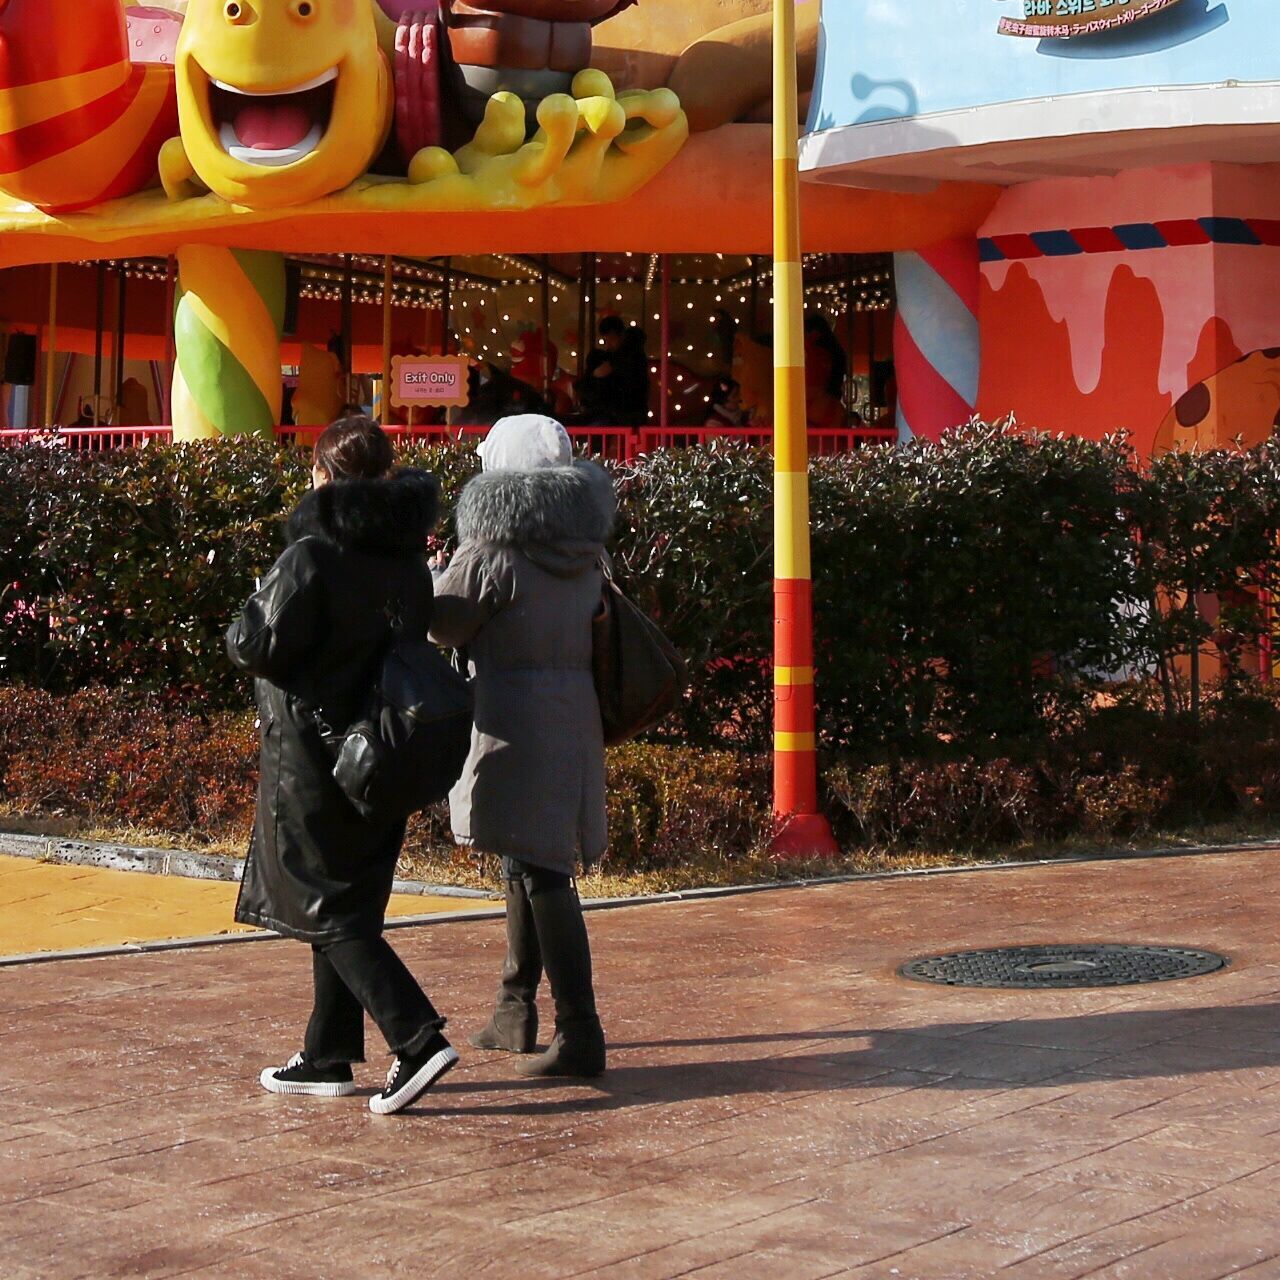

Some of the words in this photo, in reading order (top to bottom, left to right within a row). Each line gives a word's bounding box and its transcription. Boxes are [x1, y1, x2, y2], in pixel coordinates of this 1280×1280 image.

[1023, 0, 1052, 16] 라바
[405, 372, 428, 384] Exit
[430, 372, 456, 386] Only
